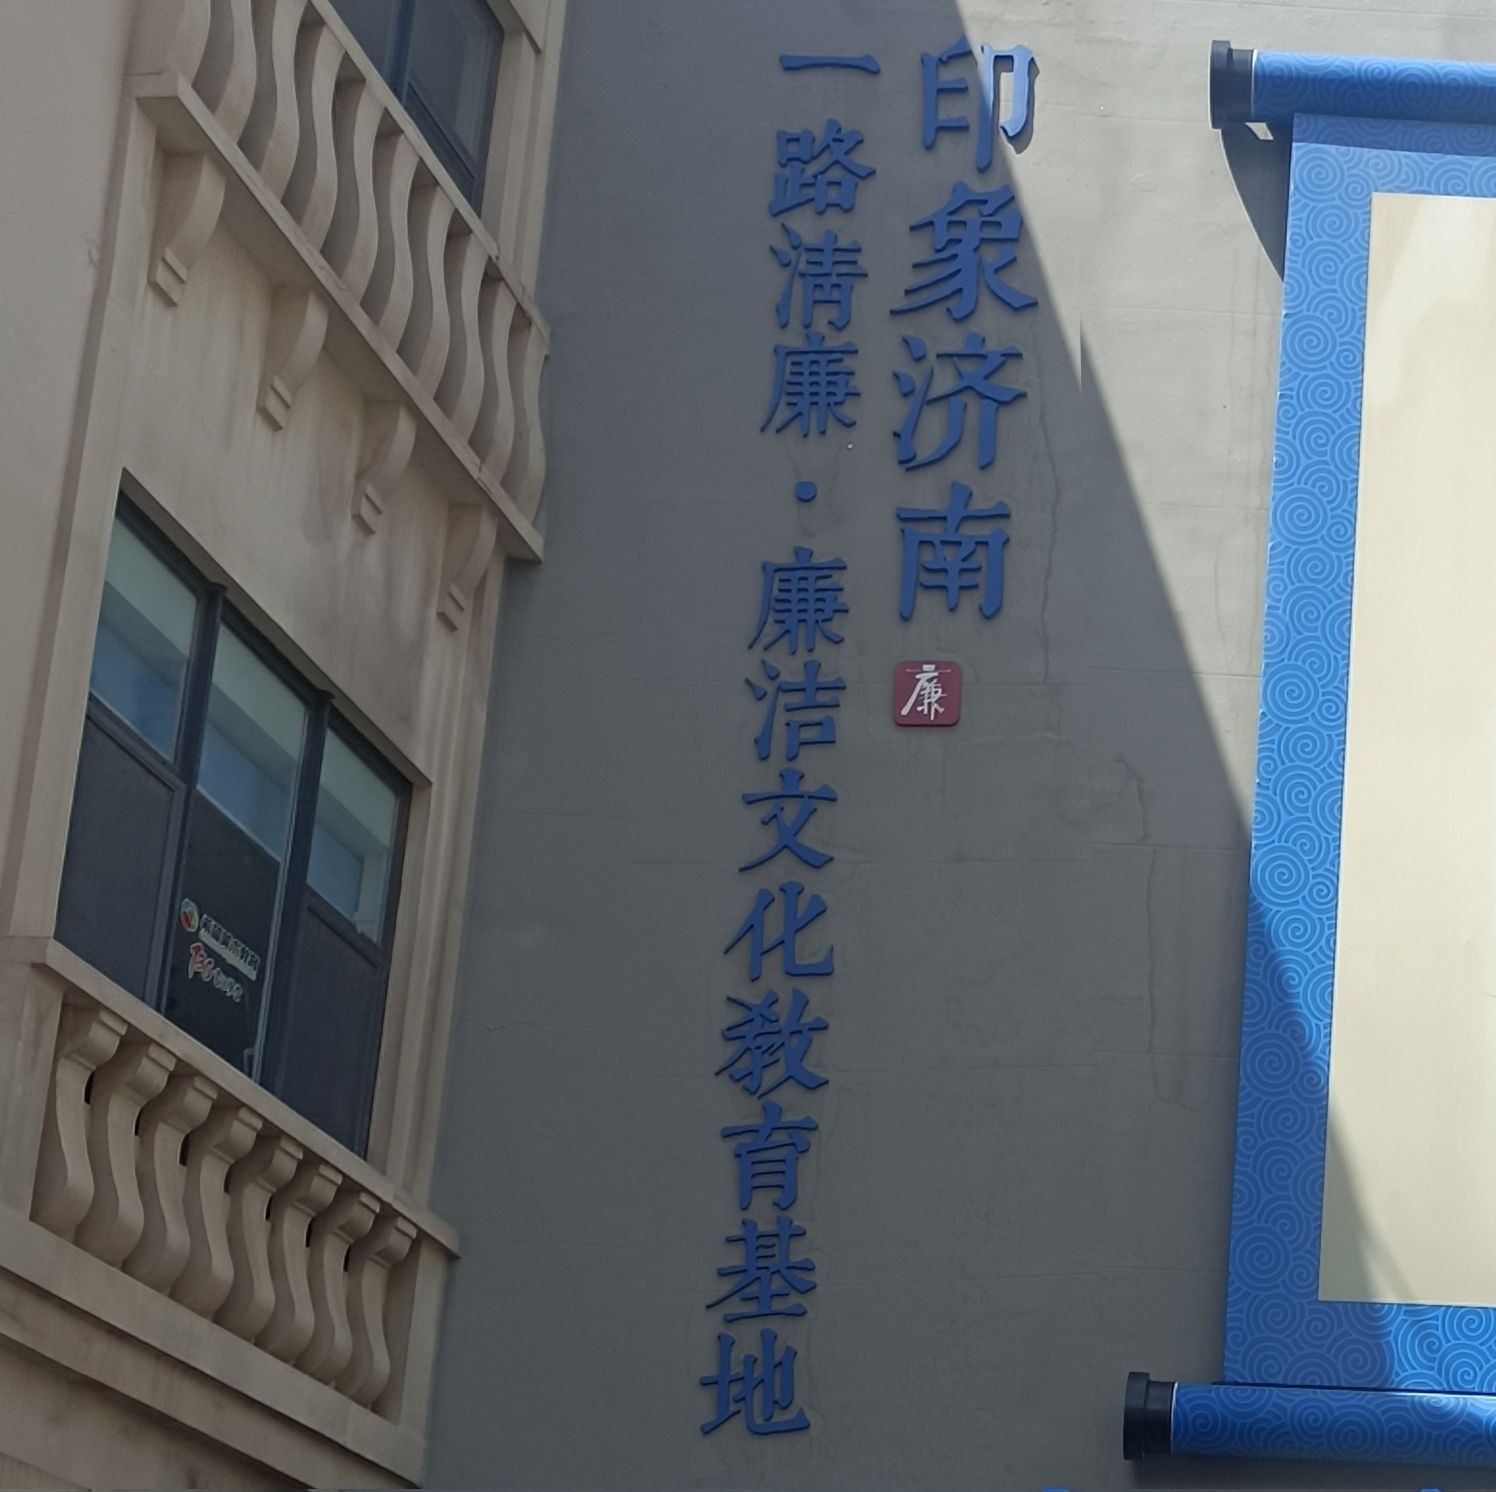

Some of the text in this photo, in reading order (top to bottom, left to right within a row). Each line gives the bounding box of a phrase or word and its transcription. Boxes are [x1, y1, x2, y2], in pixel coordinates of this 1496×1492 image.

[891, 36, 1038, 621] 印象济南
[901, 664, 952, 720] 廉
